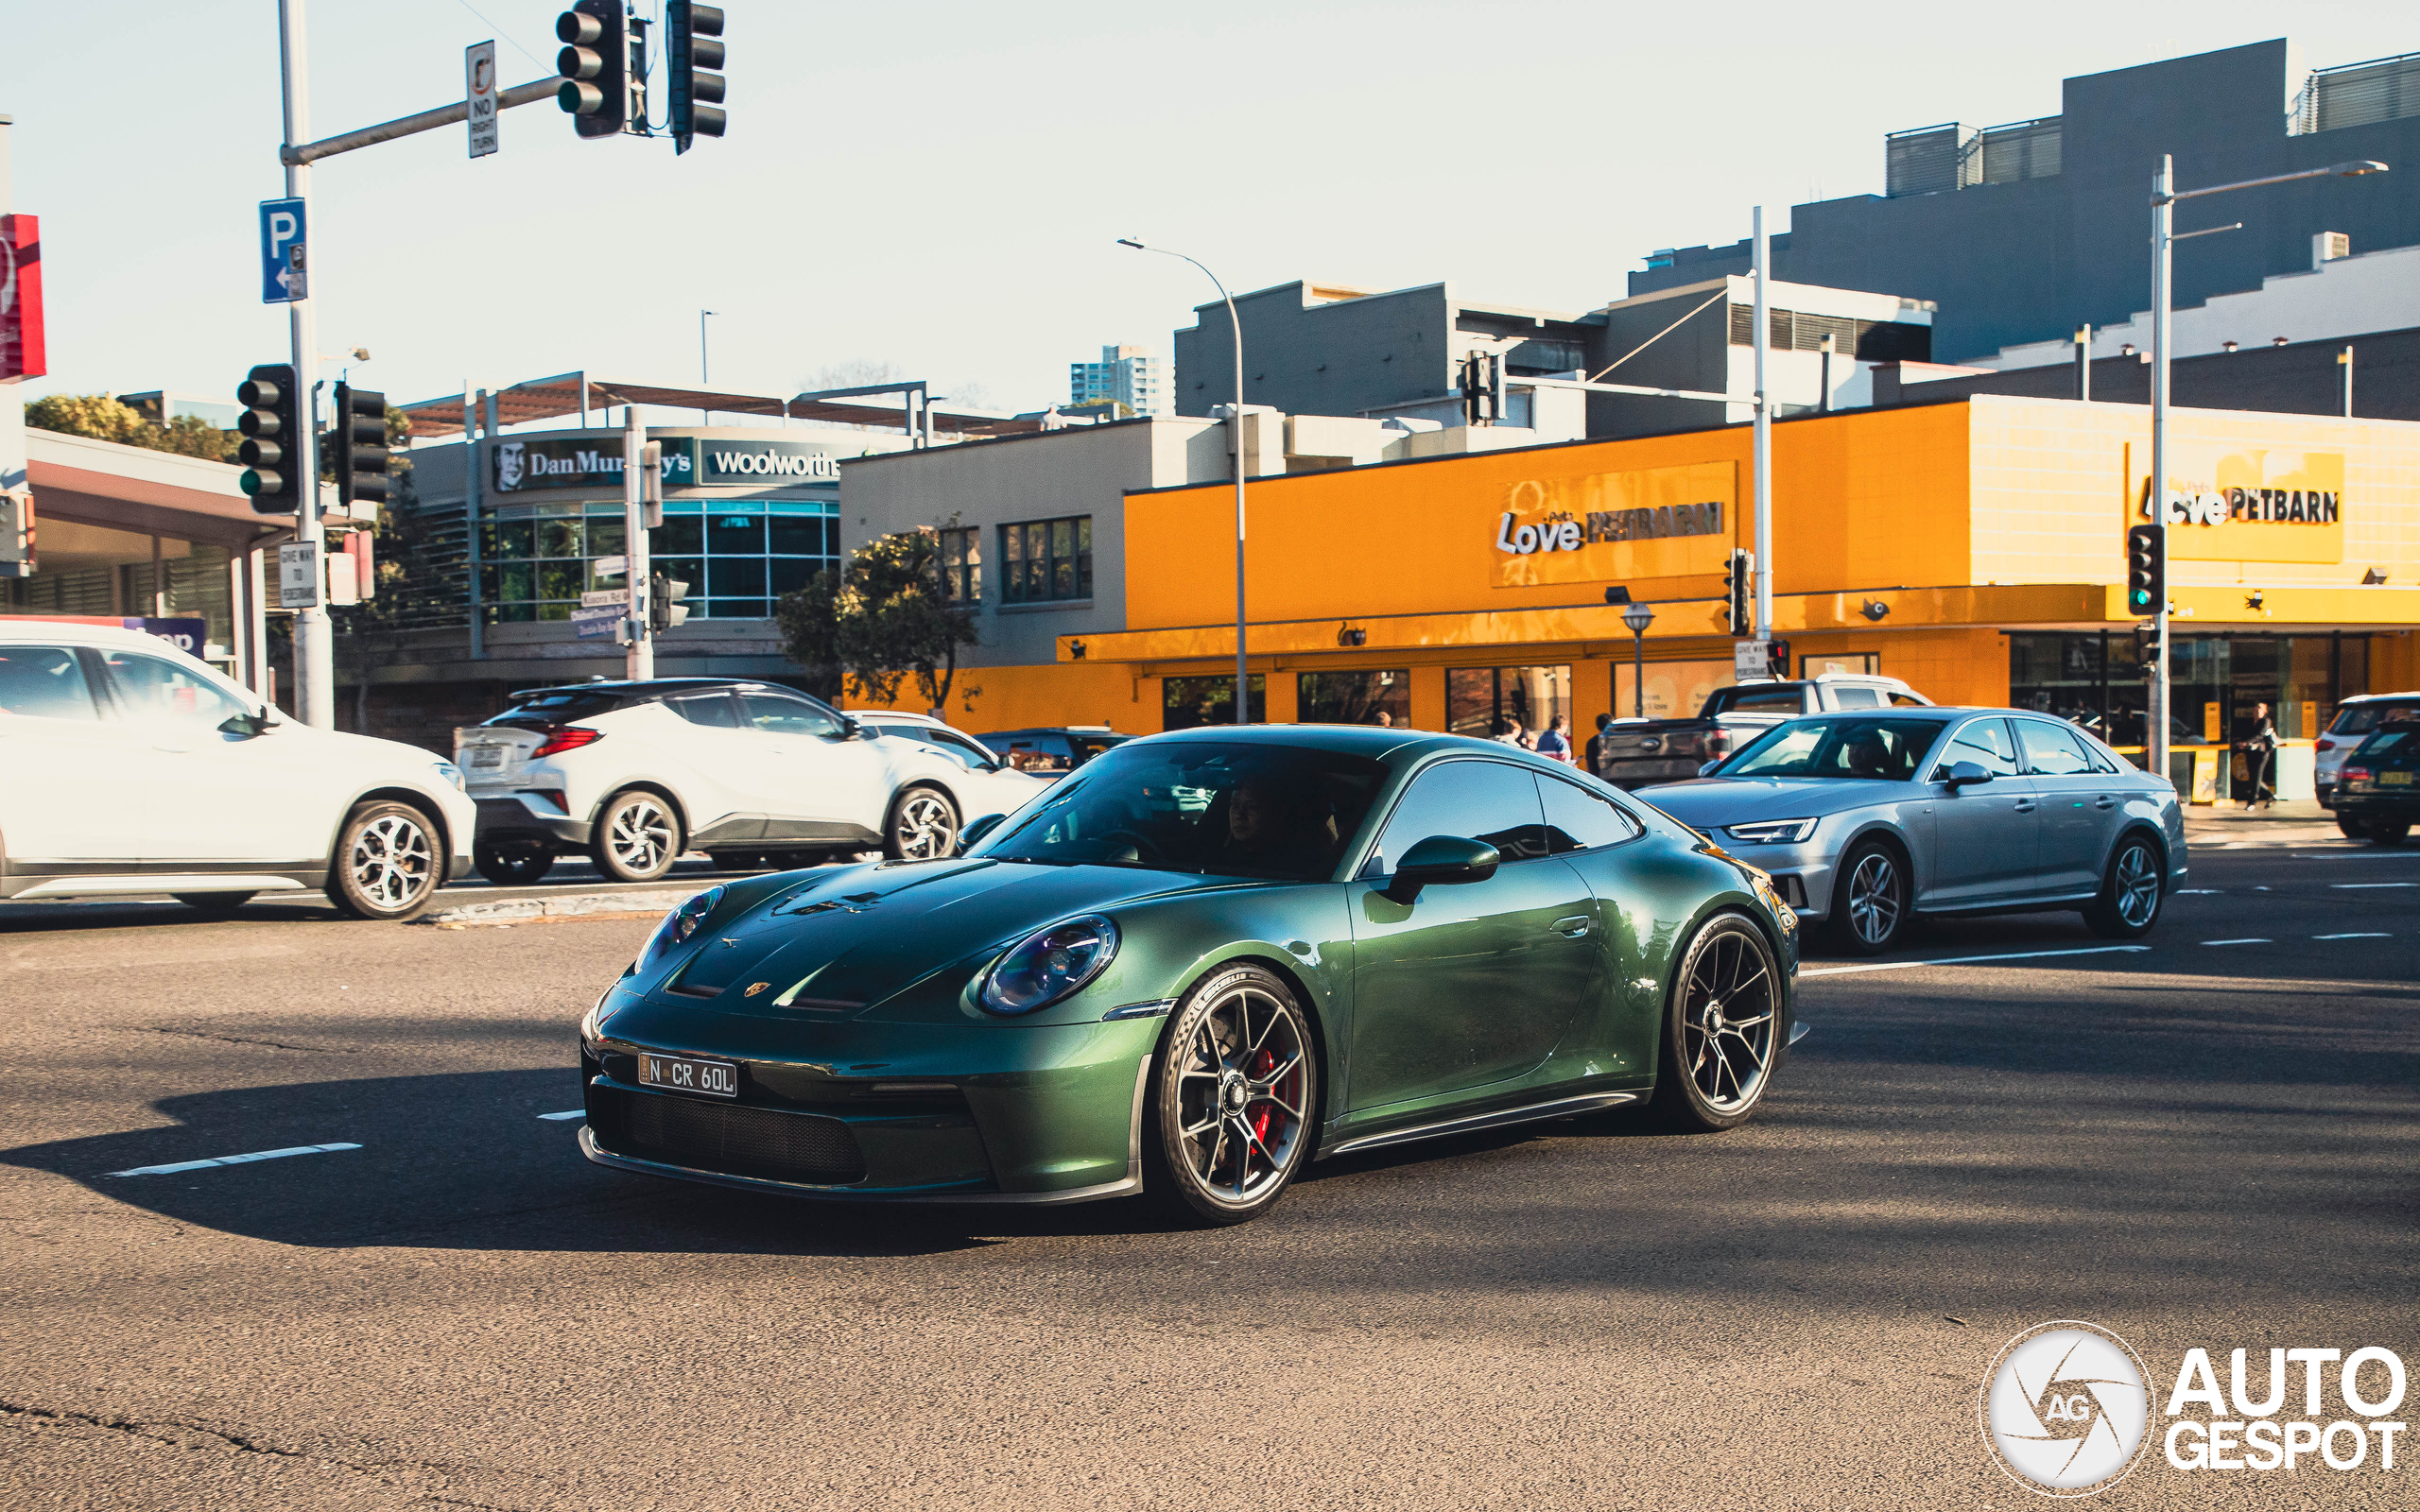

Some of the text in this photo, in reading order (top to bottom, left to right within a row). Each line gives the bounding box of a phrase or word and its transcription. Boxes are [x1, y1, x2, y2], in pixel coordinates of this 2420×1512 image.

[474, 98, 491, 117] NO
[269, 212, 297, 258] P
[576, 450, 692, 478] Mury's
[2227, 488, 2339, 524] PETBARN
[1496, 511, 1583, 555] Love
[649, 1059, 734, 1092] N CR 60L
